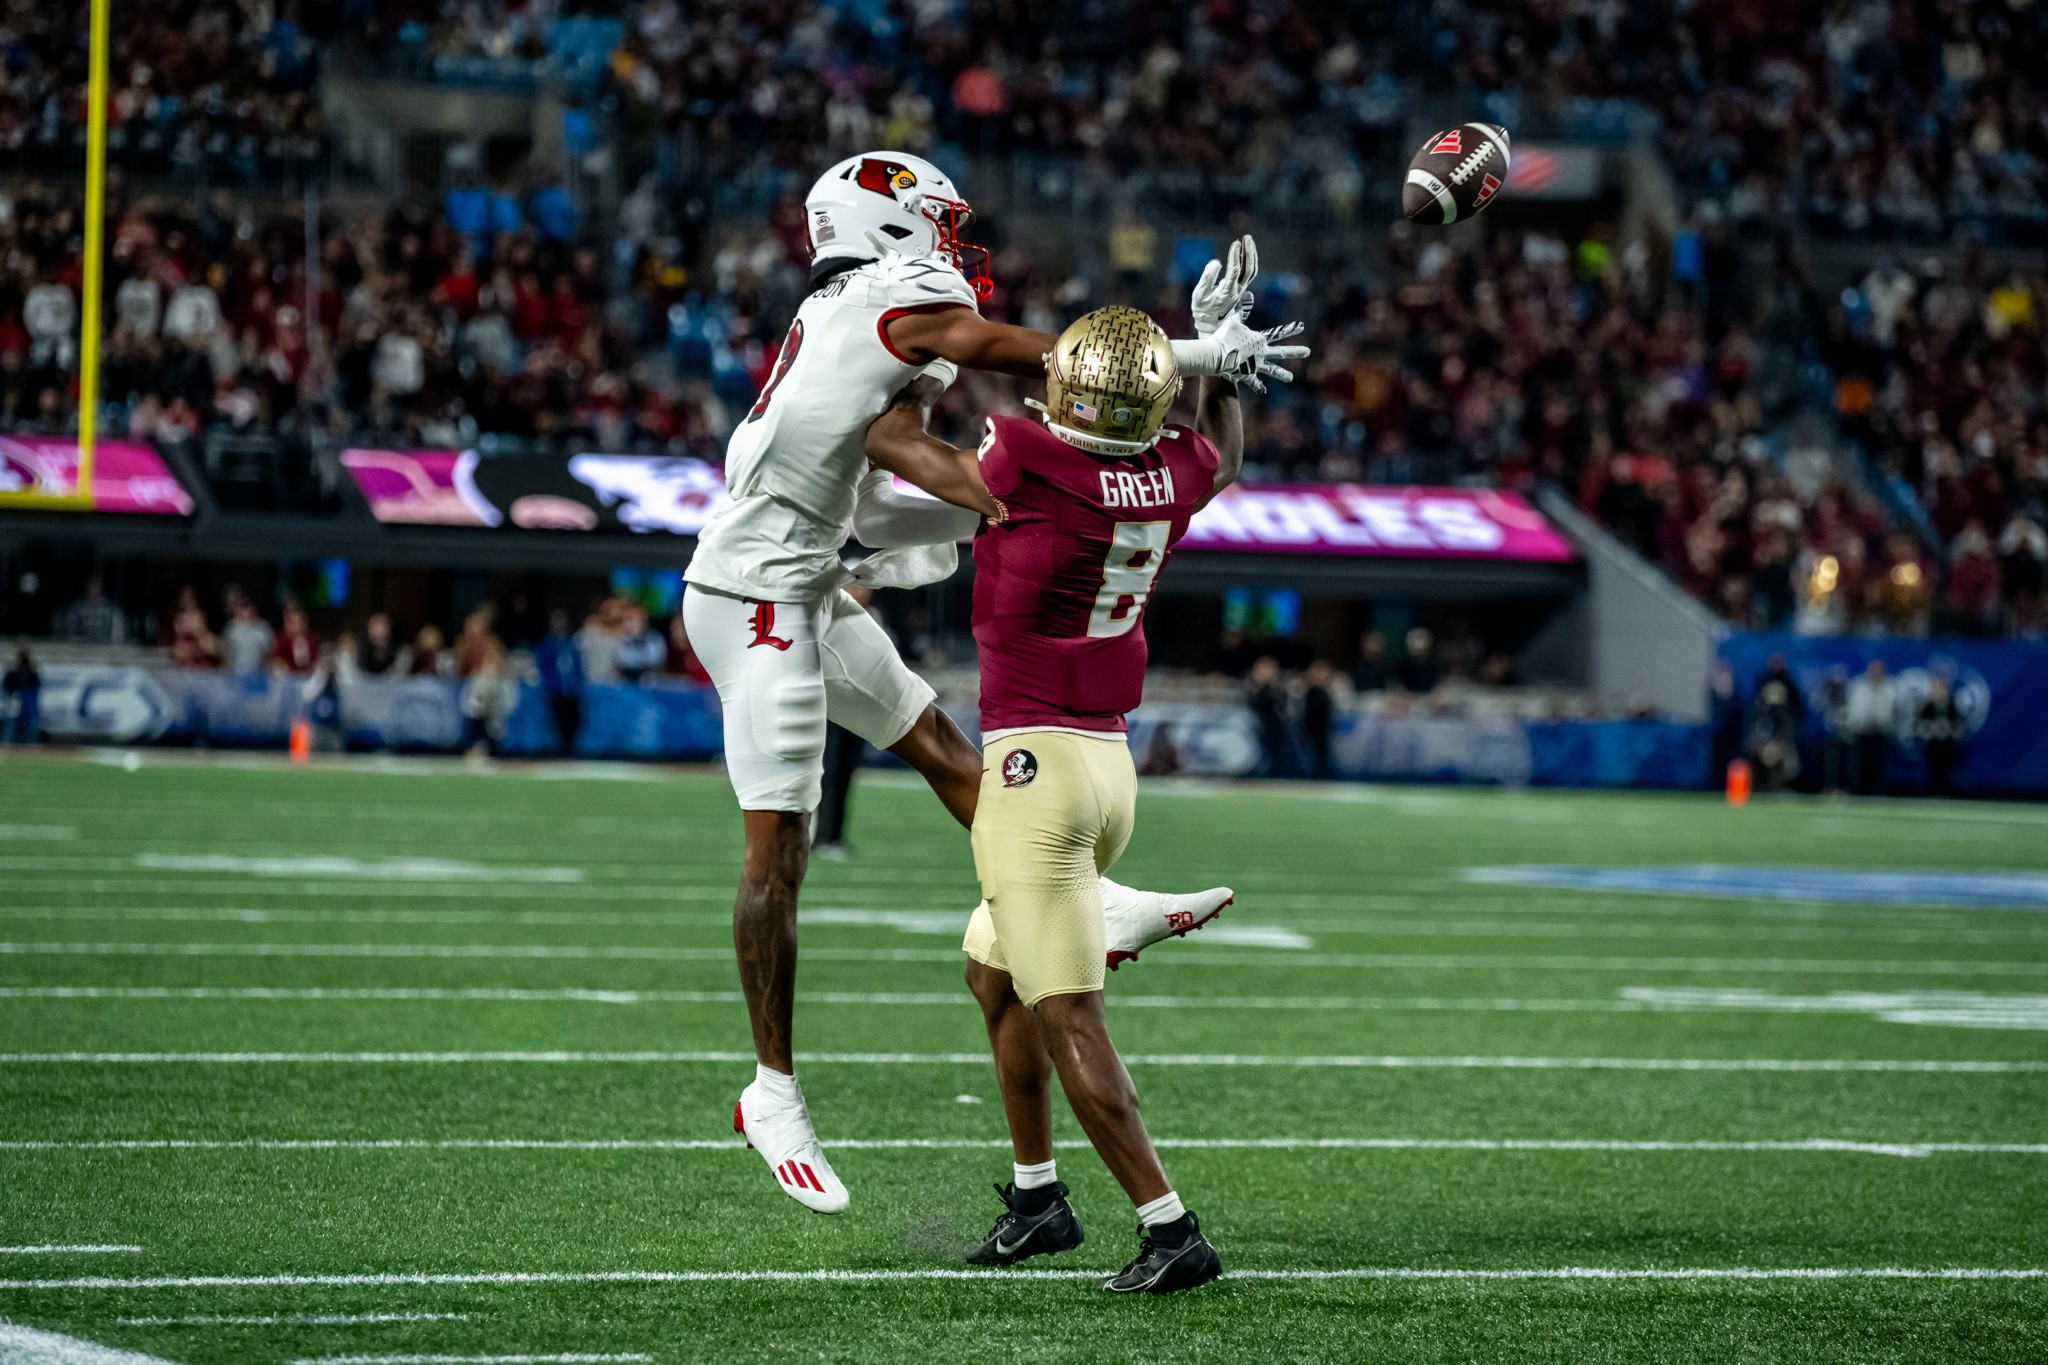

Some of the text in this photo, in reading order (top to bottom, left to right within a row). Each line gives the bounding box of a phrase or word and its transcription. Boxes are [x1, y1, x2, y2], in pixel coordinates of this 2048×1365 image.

[1059, 431, 1136, 454] FLORIDA STATE
[1099, 466, 1175, 507] GREEN
[1086, 520, 1172, 638] 8
[742, 597, 793, 651] L
